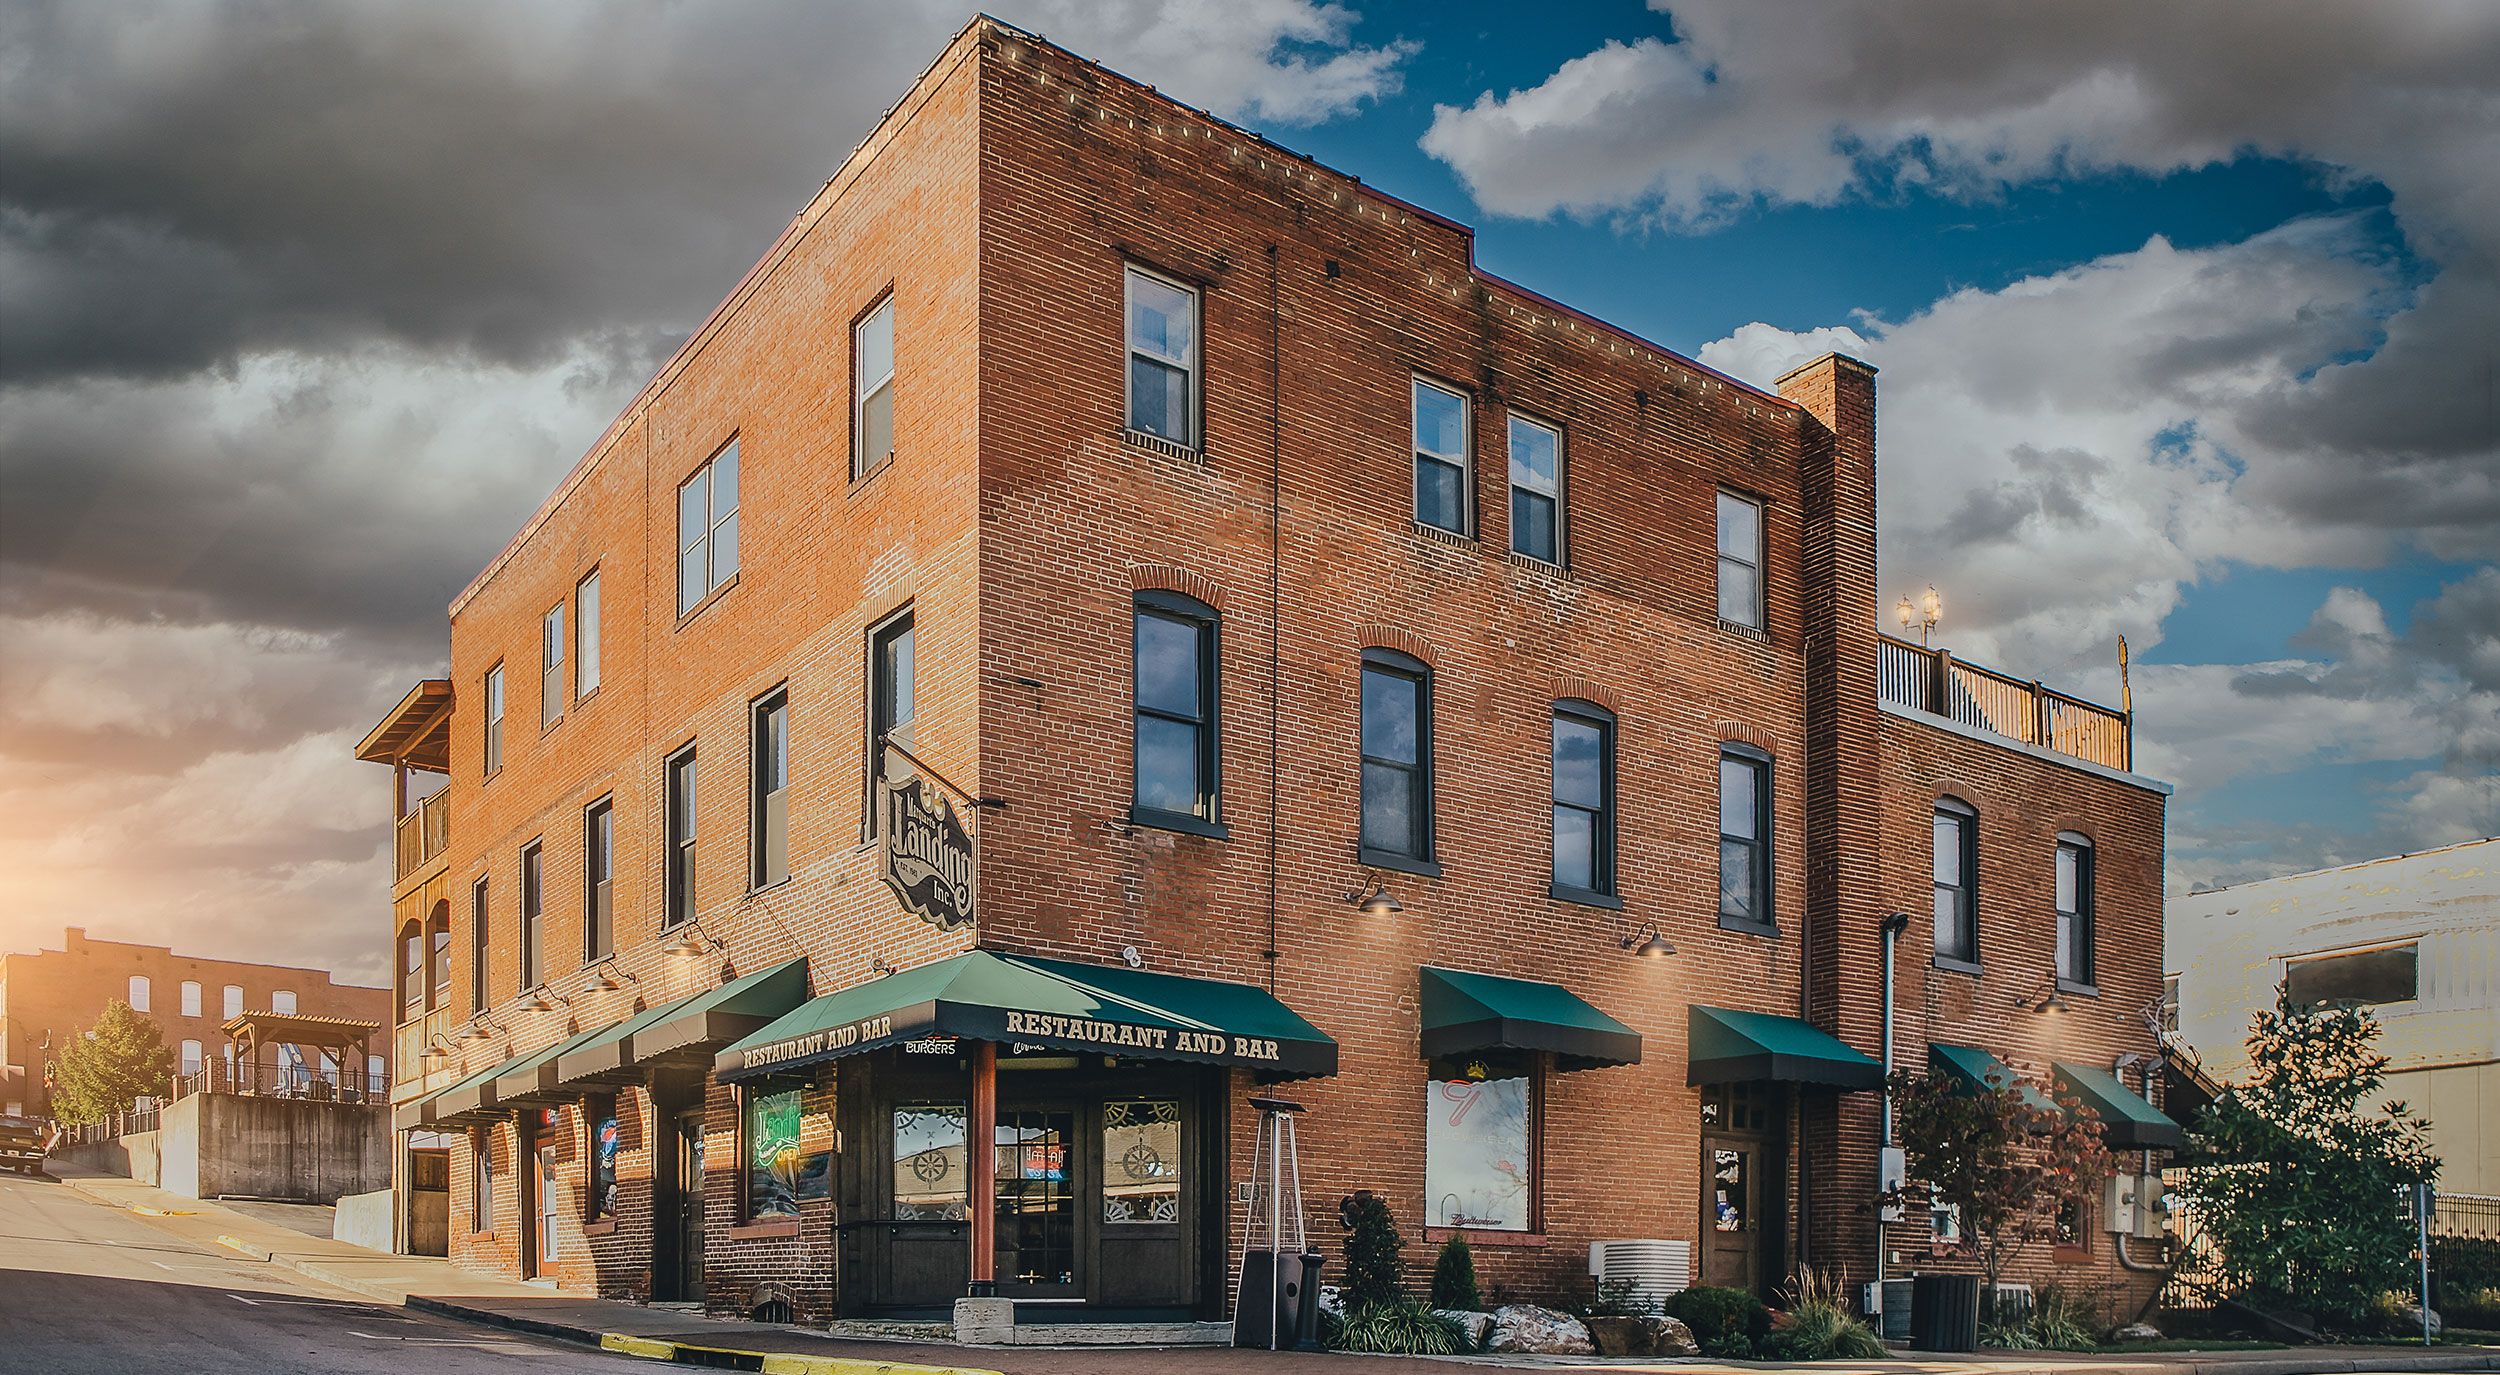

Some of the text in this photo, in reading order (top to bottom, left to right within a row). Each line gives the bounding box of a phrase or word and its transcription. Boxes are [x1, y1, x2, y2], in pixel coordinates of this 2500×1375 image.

[891, 791, 974, 917] Landing
[933, 880, 953, 908] Inc.
[743, 1016, 892, 1069] RESTAURANT AND BAR
[905, 1041, 956, 1055] BURGERS
[1006, 1011, 1167, 1049] RESTAURANT
[1175, 1031, 1227, 1055] AND
[1234, 1037, 1281, 1061] BAR
